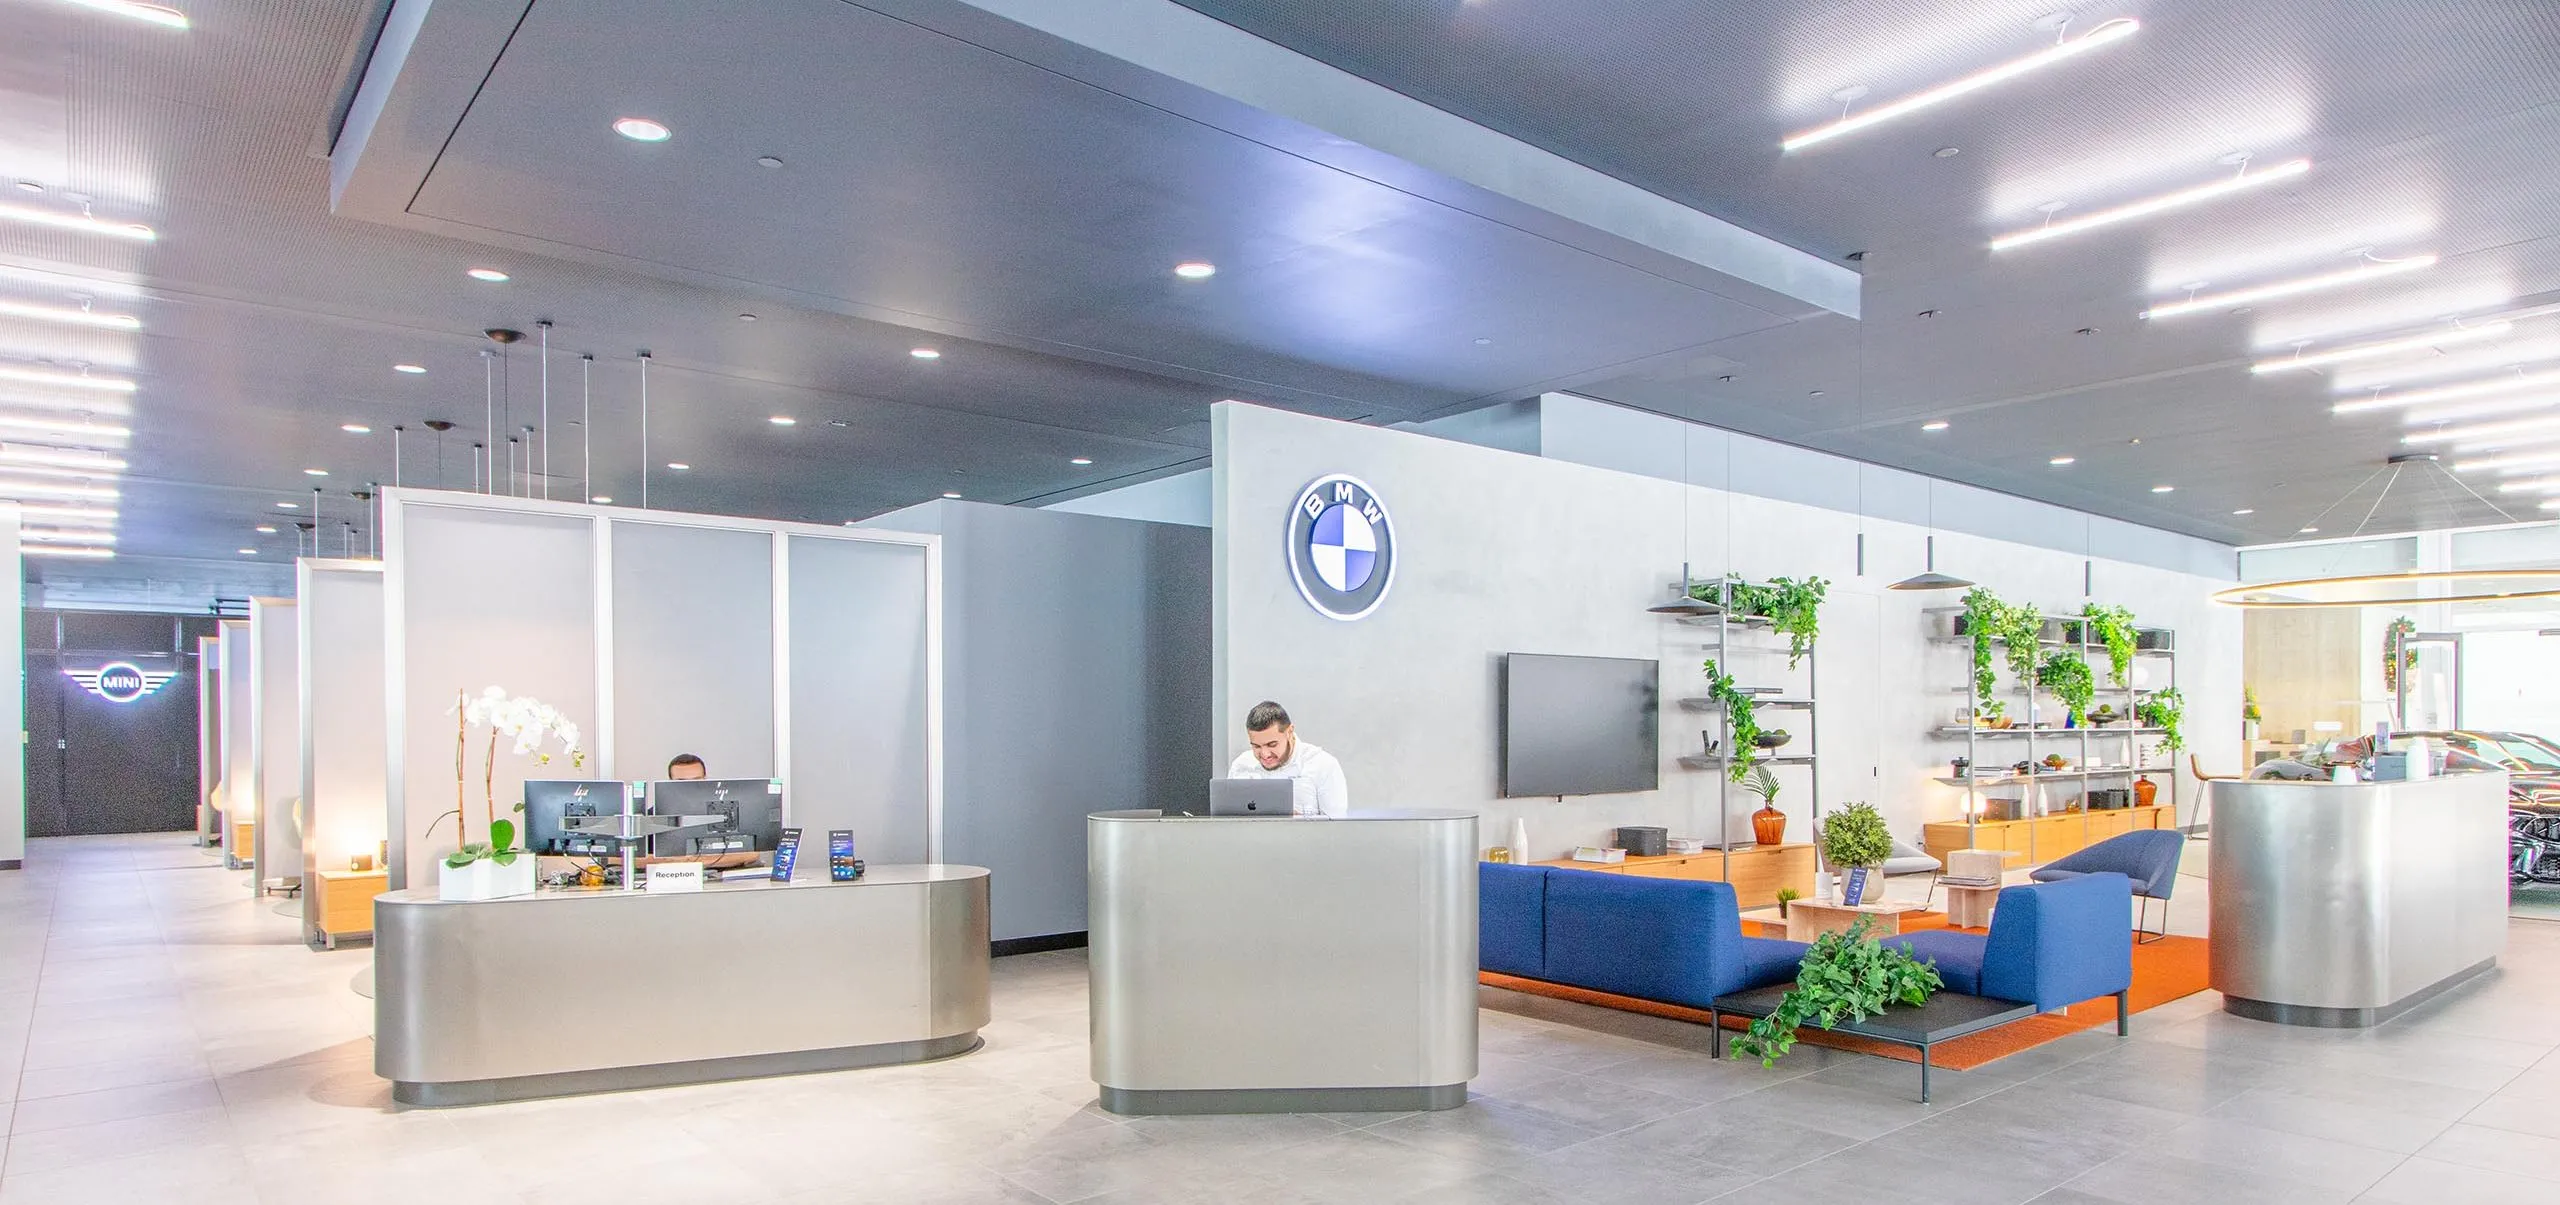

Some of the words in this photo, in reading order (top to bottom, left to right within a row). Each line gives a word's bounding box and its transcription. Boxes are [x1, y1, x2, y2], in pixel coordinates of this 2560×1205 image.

[1304, 482, 1384, 525] BMW
[103, 677, 140, 688] MINI
[715, 781, 729, 800] hp
